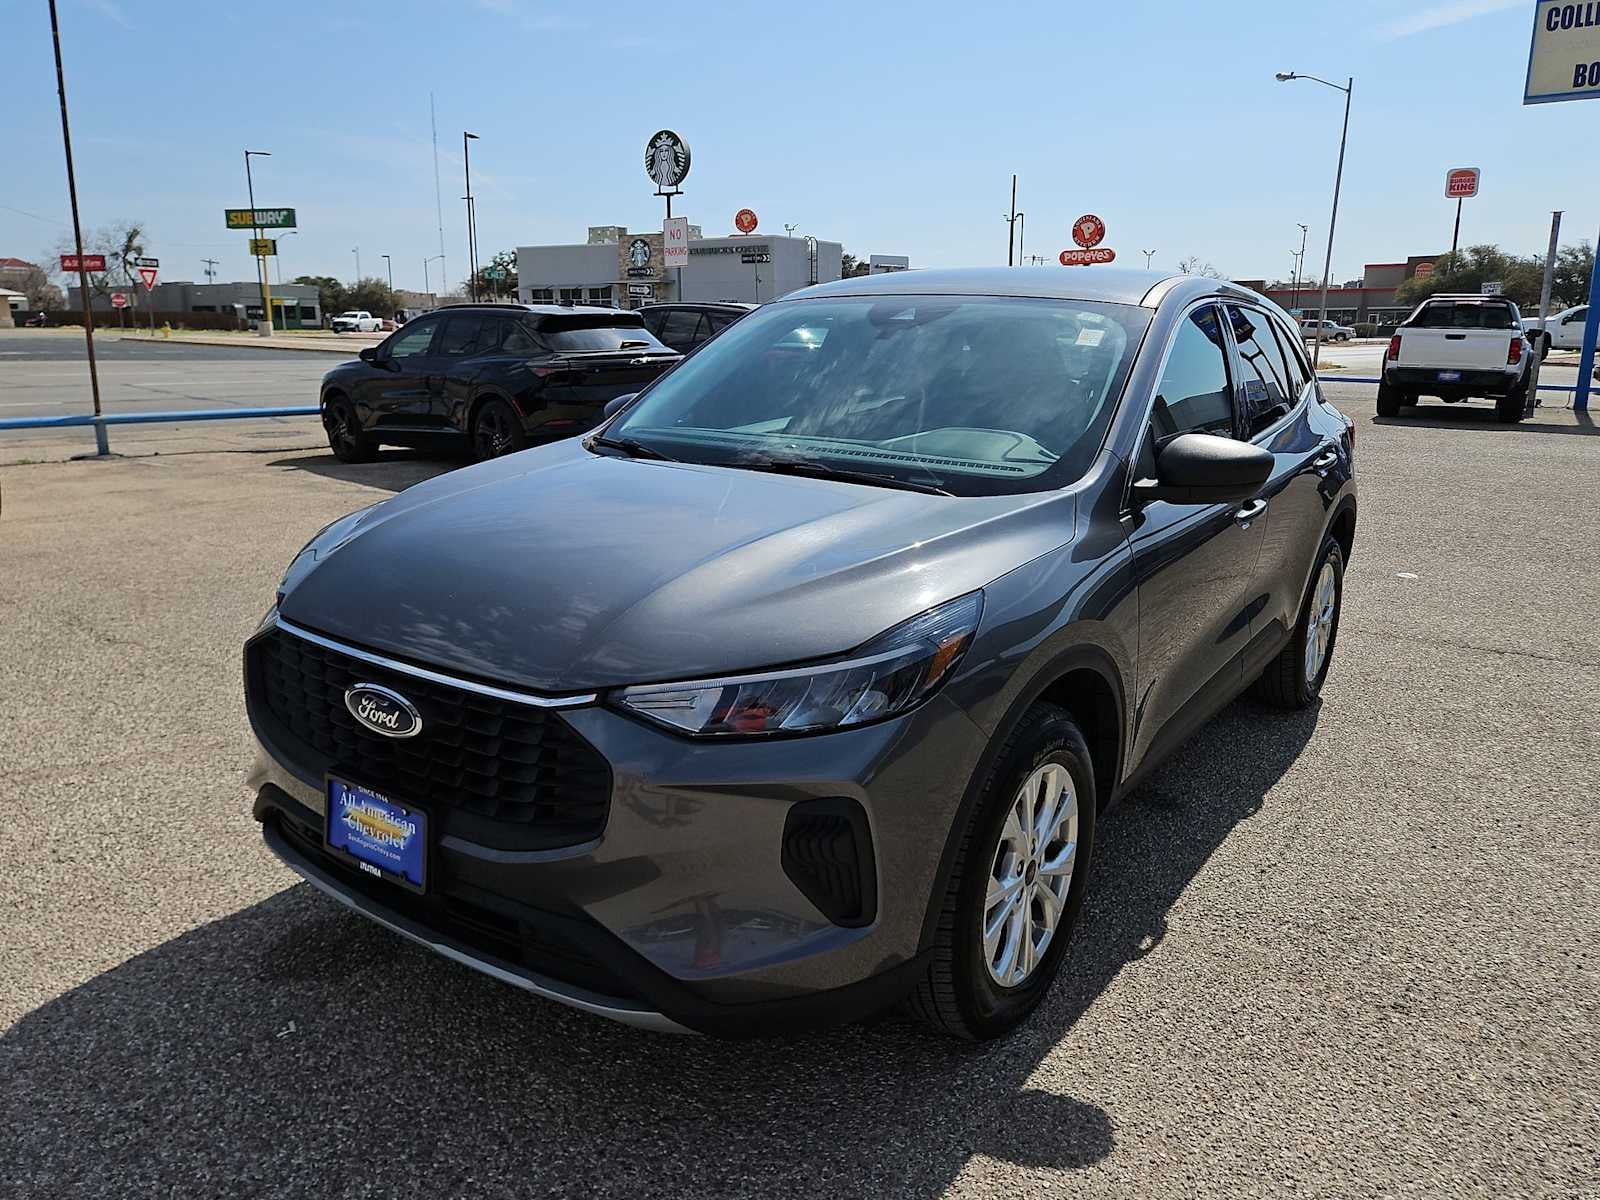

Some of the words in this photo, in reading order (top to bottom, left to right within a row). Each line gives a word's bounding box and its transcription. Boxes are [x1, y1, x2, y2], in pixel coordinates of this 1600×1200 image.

[1449, 183, 1475, 191] KING
[670, 229, 682, 241] NO
[664, 246, 688, 257] PARKING
[358, 694, 400, 728] Ford
[339, 791, 357, 809] All
[359, 799, 416, 835] American
[346, 814, 405, 850] Chevrolet
